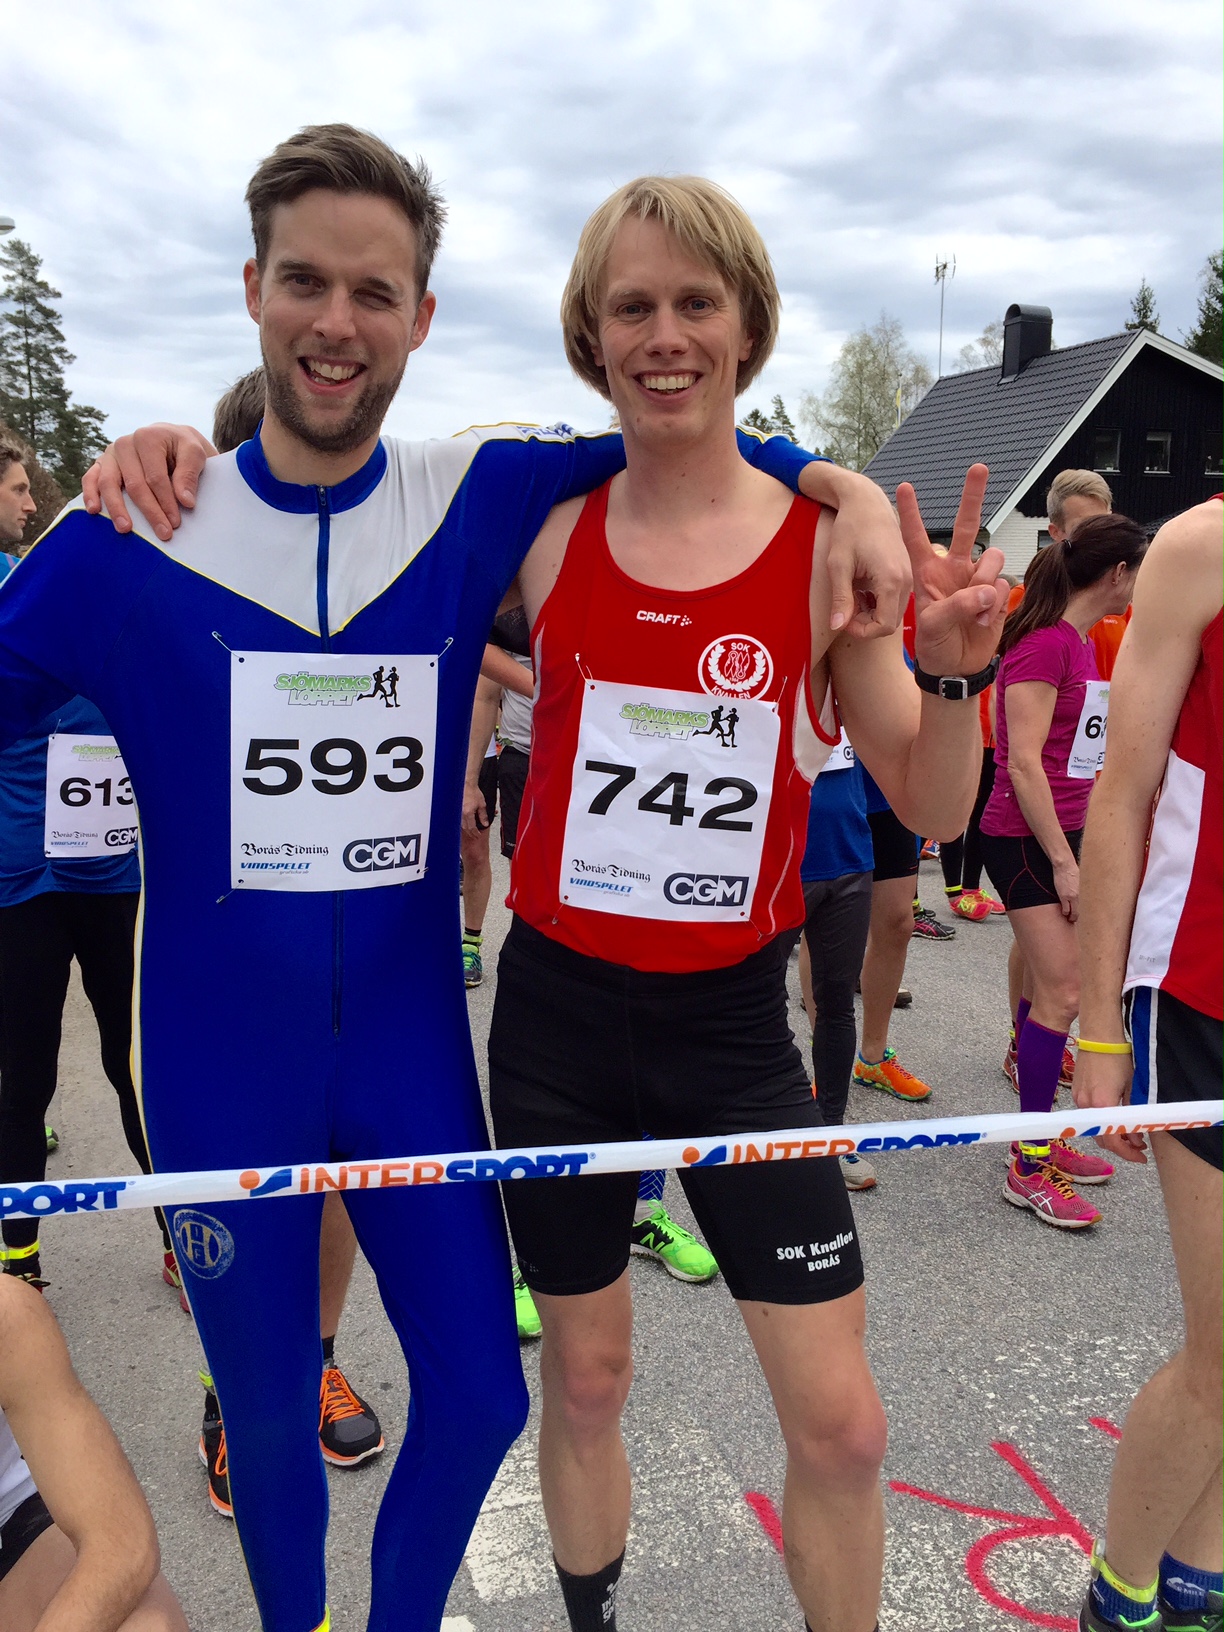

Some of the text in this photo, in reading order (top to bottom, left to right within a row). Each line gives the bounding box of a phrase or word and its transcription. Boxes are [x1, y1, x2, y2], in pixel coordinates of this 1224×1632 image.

[635, 610, 681, 625] CRAFT
[730, 642, 751, 653] SOK
[274, 671, 372, 693] SJÖMARKS
[288, 689, 358, 706] LOPPET
[619, 702, 711, 728] SJÖMARKS
[629, 718, 694, 741] LOPPET
[242, 736, 425, 796] 593
[59, 777, 134, 807] 613
[584, 760, 758, 832] 742
[106, 827, 138, 847] CGM
[240, 842, 329, 857] Borås Tidning
[347, 836, 419, 871] CGM
[571, 858, 651, 884] Borås Tidning
[667, 877, 746, 905] CGM
[299, 1152, 589, 1194] INTERSPORT
[776, 1230, 854, 1261] SOK Knallen
[807, 1253, 841, 1272] BORÅS
